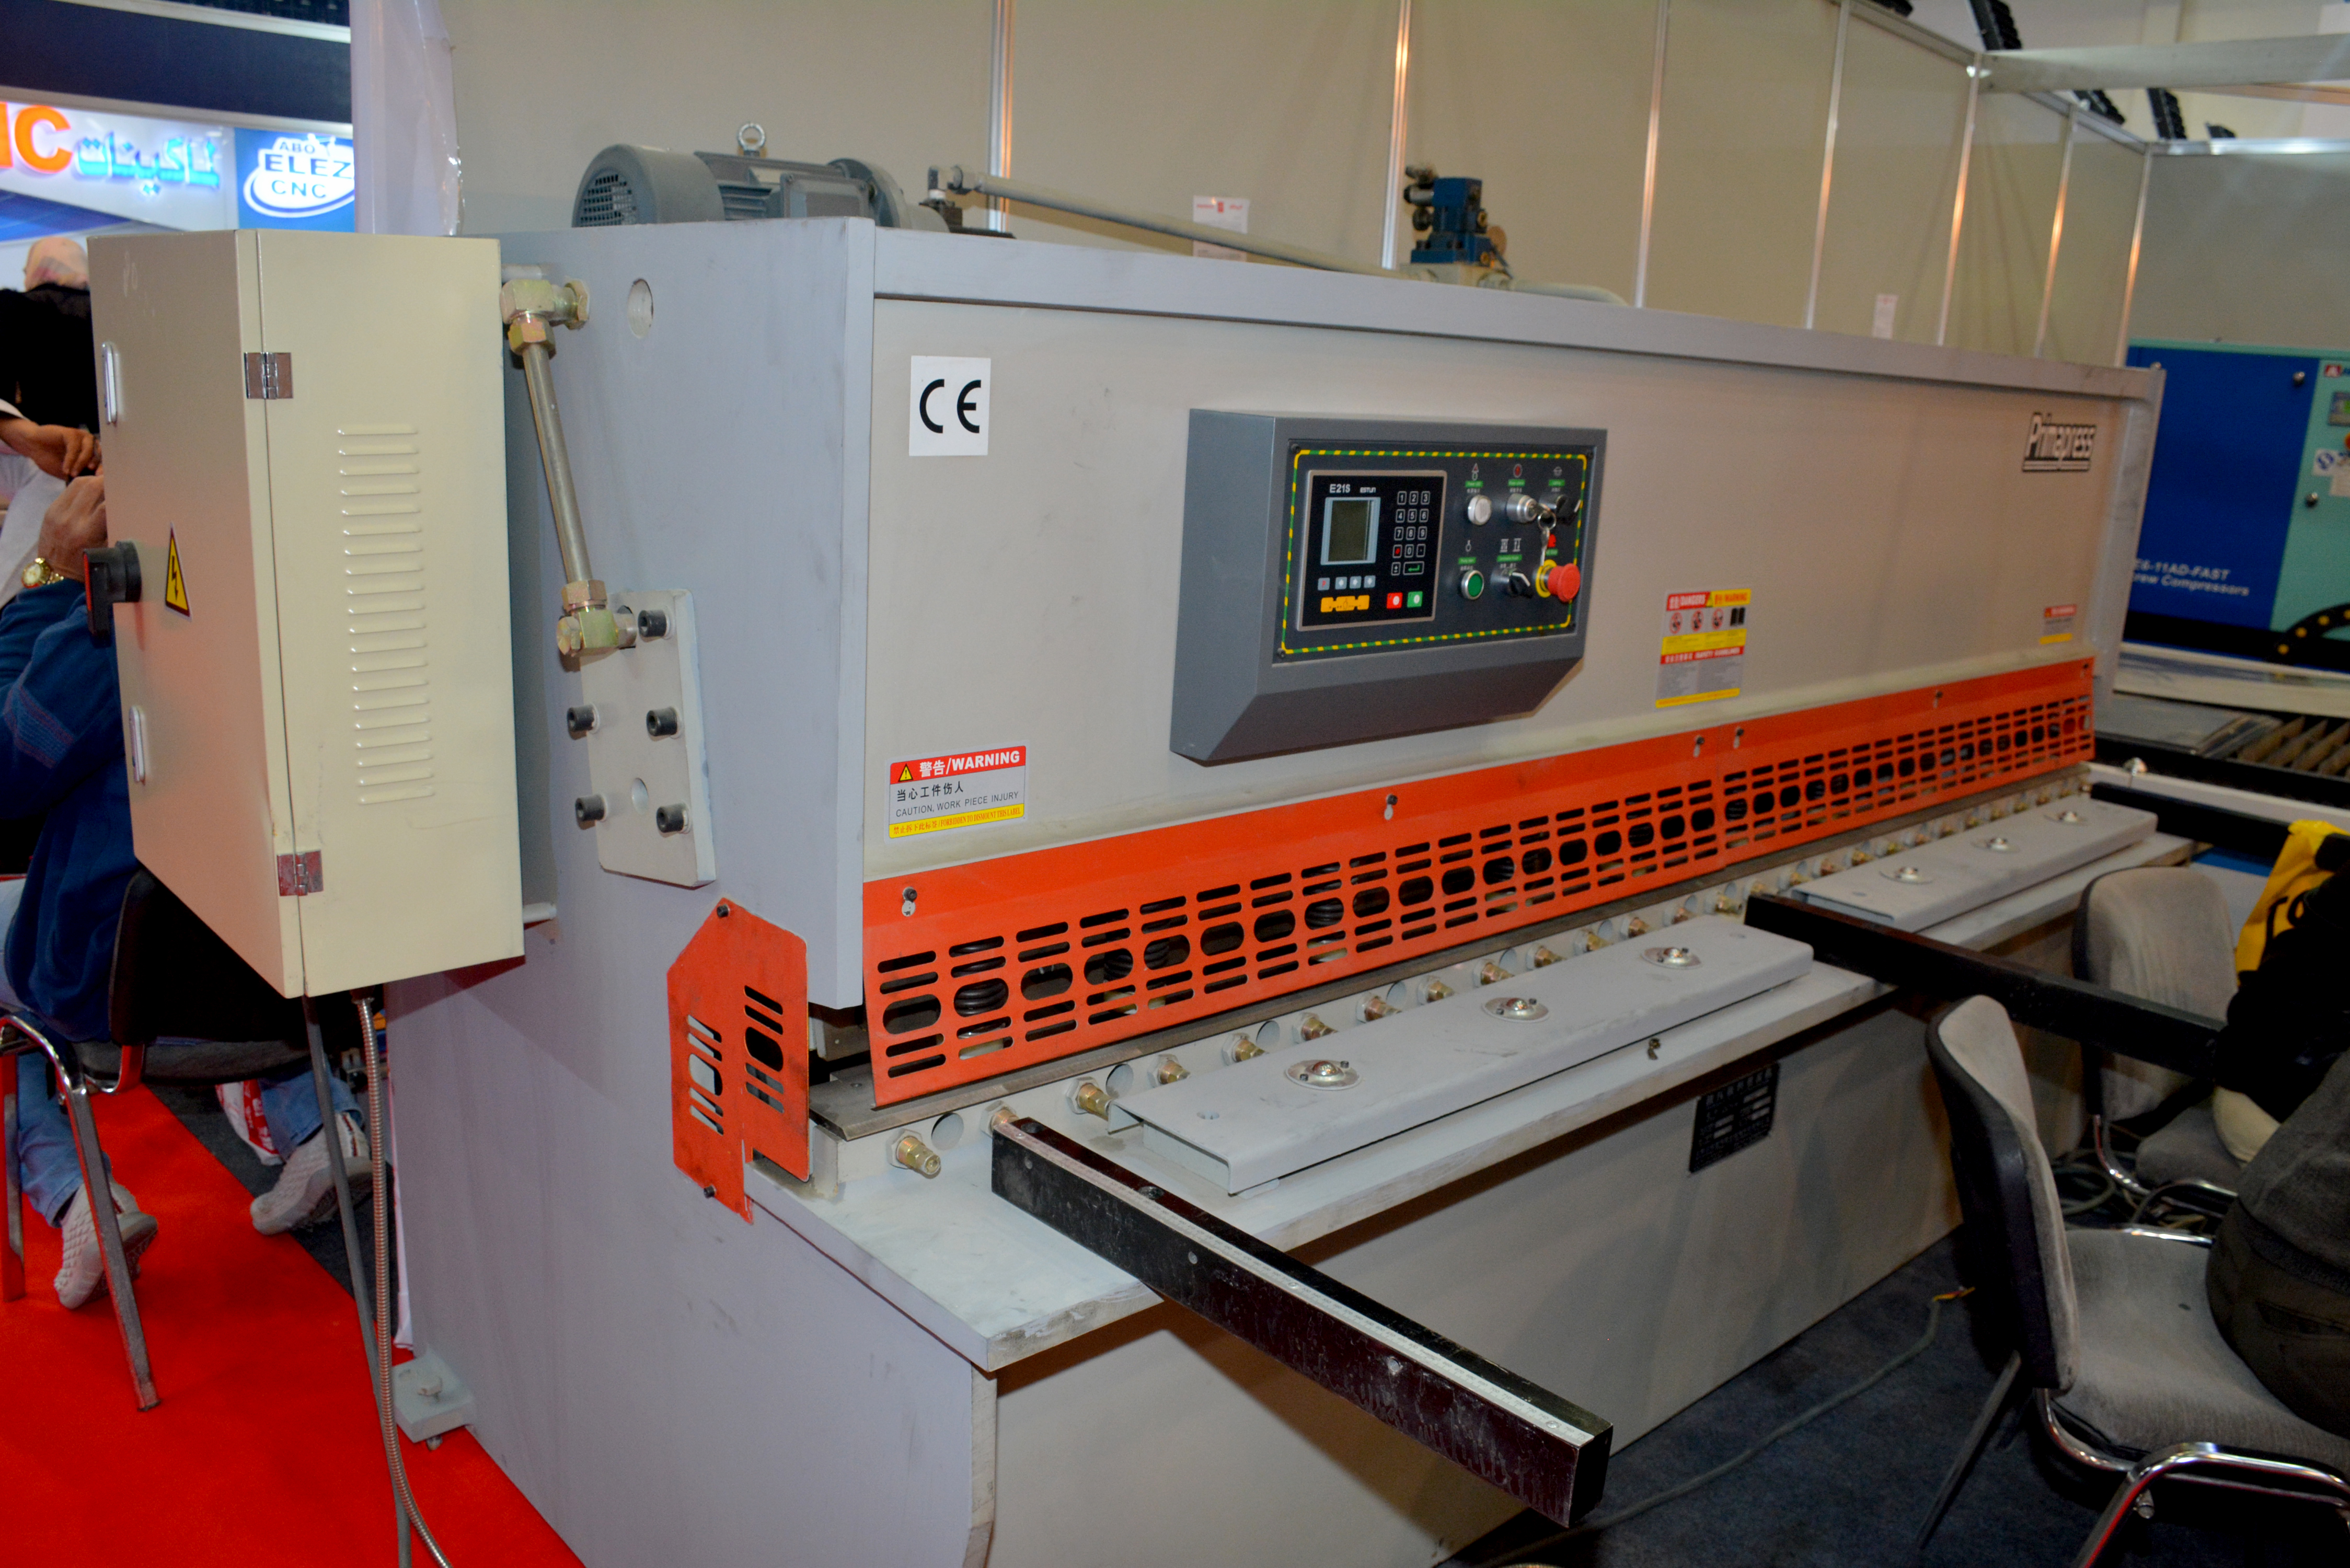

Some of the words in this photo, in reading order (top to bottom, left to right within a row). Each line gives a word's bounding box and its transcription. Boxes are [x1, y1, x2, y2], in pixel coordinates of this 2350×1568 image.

[279, 141, 315, 154] ABO
[271, 180, 327, 199] CNC
[919, 378, 981, 433] CE
[896, 780, 964, 802] 当心工件伤人
[895, 805, 935, 817] CAUTION,
[937, 800, 961, 811] WORK
[964, 795, 988, 807] PIECE
[991, 791, 1019, 802] INJURY
